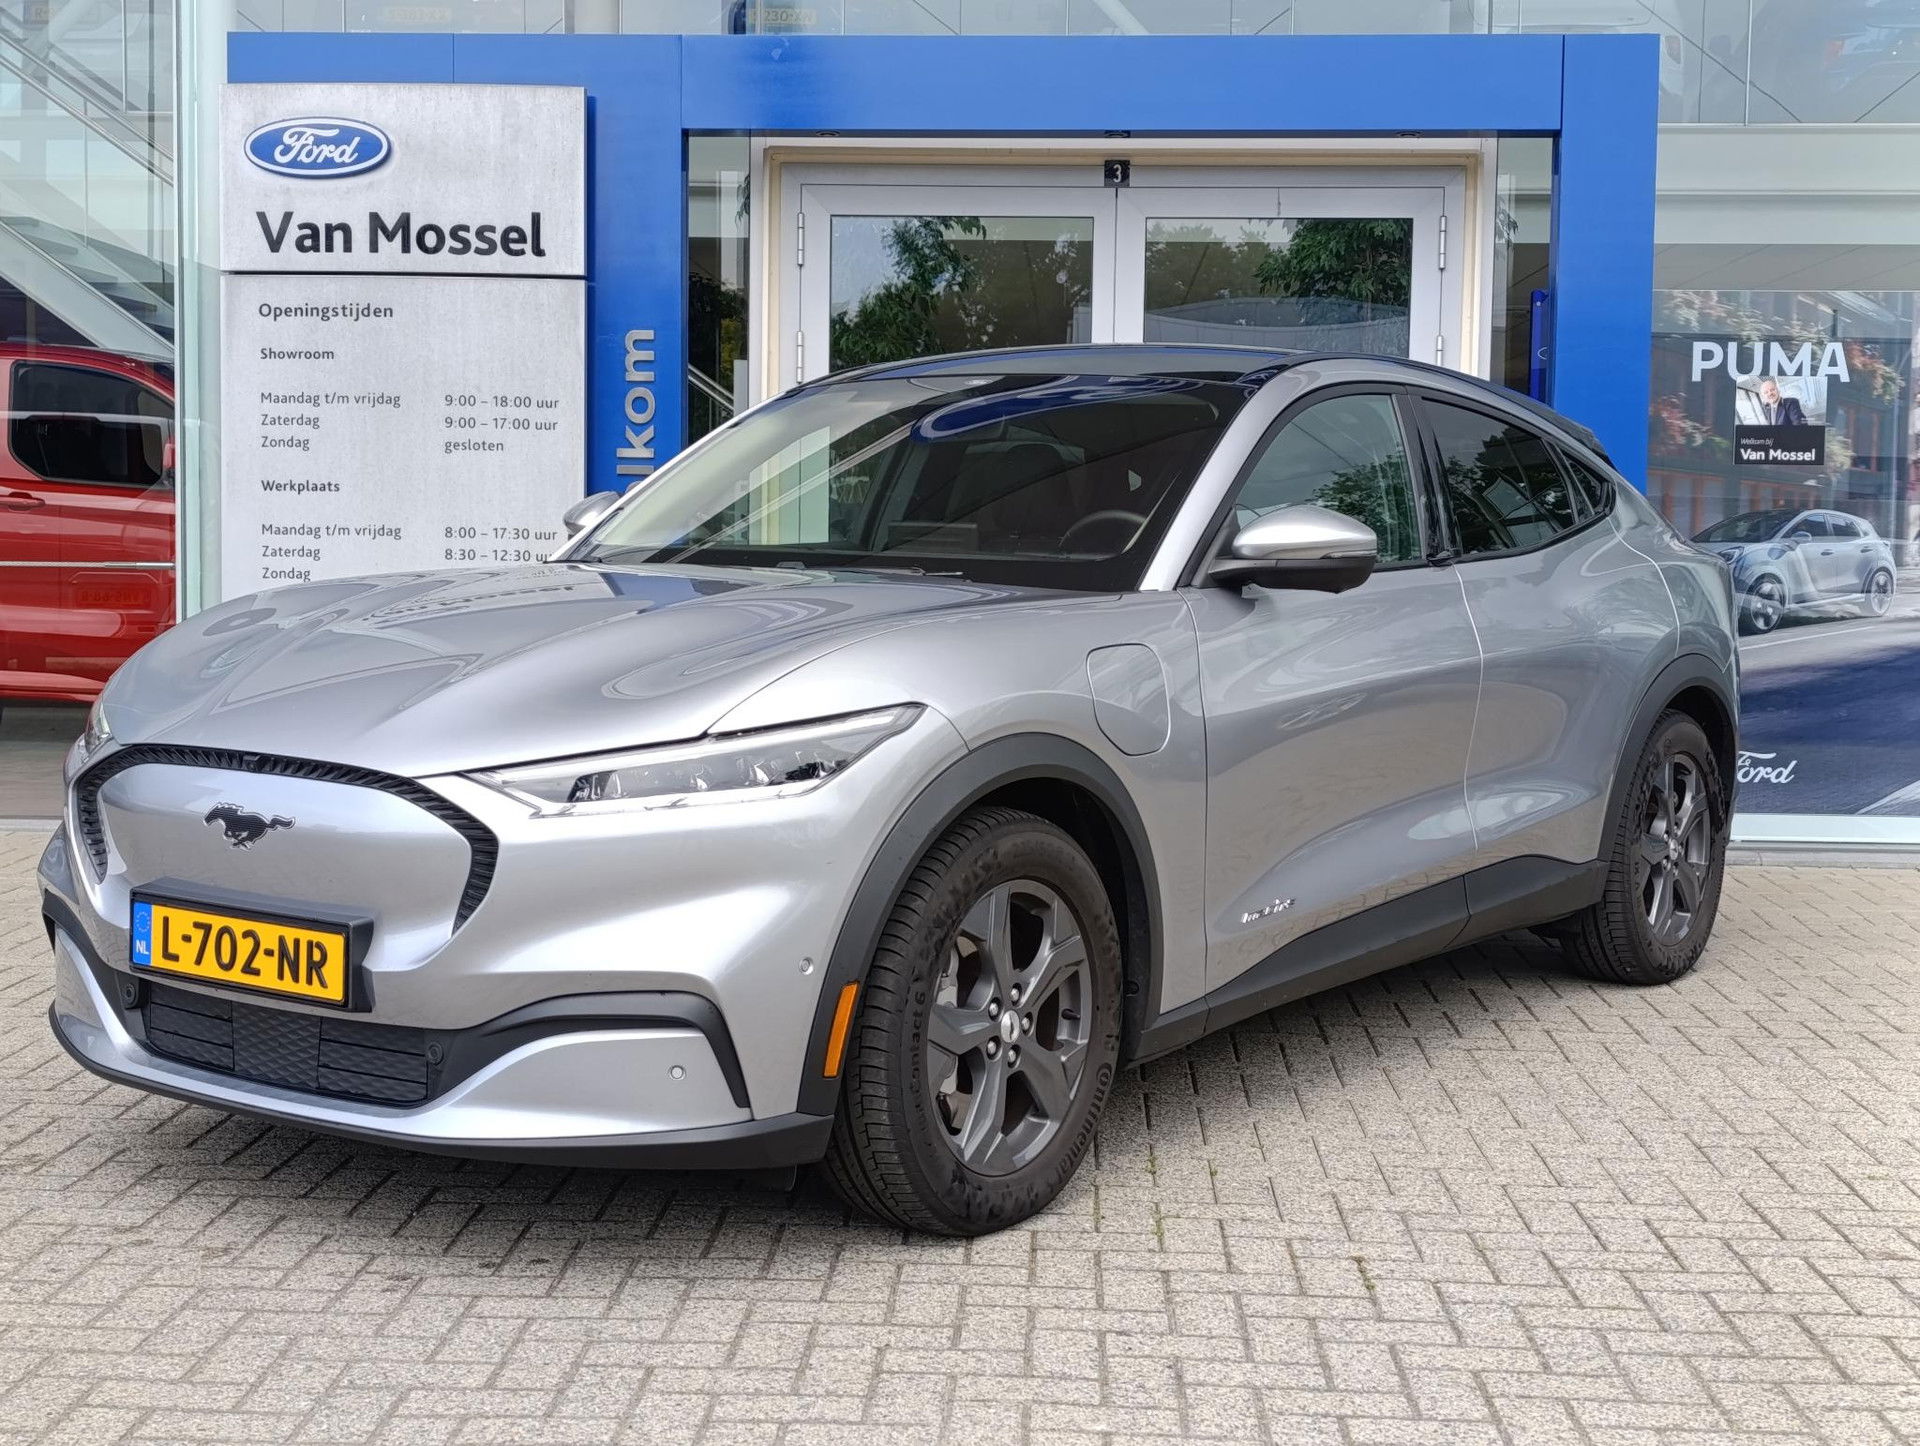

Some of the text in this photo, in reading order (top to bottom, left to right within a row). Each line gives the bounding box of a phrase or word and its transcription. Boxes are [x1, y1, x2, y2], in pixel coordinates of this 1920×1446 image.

[274, 127, 360, 163] Ford
[1113, 164, 1122, 183] 3
[256, 211, 546, 257] Van Mossel
[259, 303, 394, 321] Openingstijden
[260, 348, 335, 360] Showroom
[1691, 341, 1850, 382] PUMA
[260, 392, 320, 407] Maandag
[325, 392, 350, 404] t/m
[354, 392, 401, 408] vrijdag
[444, 394, 477, 407] 9:00
[492, 395, 532, 408] 18:00
[536, 399, 559, 409] uur
[261, 413, 320, 429] Zaterdag
[444, 416, 477, 429] 9:00
[492, 417, 531, 430] 17:00
[535, 421, 559, 431] uur
[261, 435, 504, 454] Zondag gesloten
[1740, 447, 1816, 461] Van Mossel
[261, 479, 341, 495] Werkplaats
[261, 523, 322, 539] Maandag
[325, 523, 350, 537] t/m
[354, 524, 402, 540] vrijdag
[444, 526, 477, 539] 8:00
[492, 527, 530, 540] 17:30
[534, 531, 558, 541] uur
[261, 545, 321, 561] Zaterdag
[444, 548, 477, 561] 8:30
[491, 549, 531, 562] 12:30
[261, 567, 311, 582] Zondag
[1736, 750, 1798, 784] Ford
[135, 939, 150, 955] NL
[162, 915, 329, 989] L-702-NR
